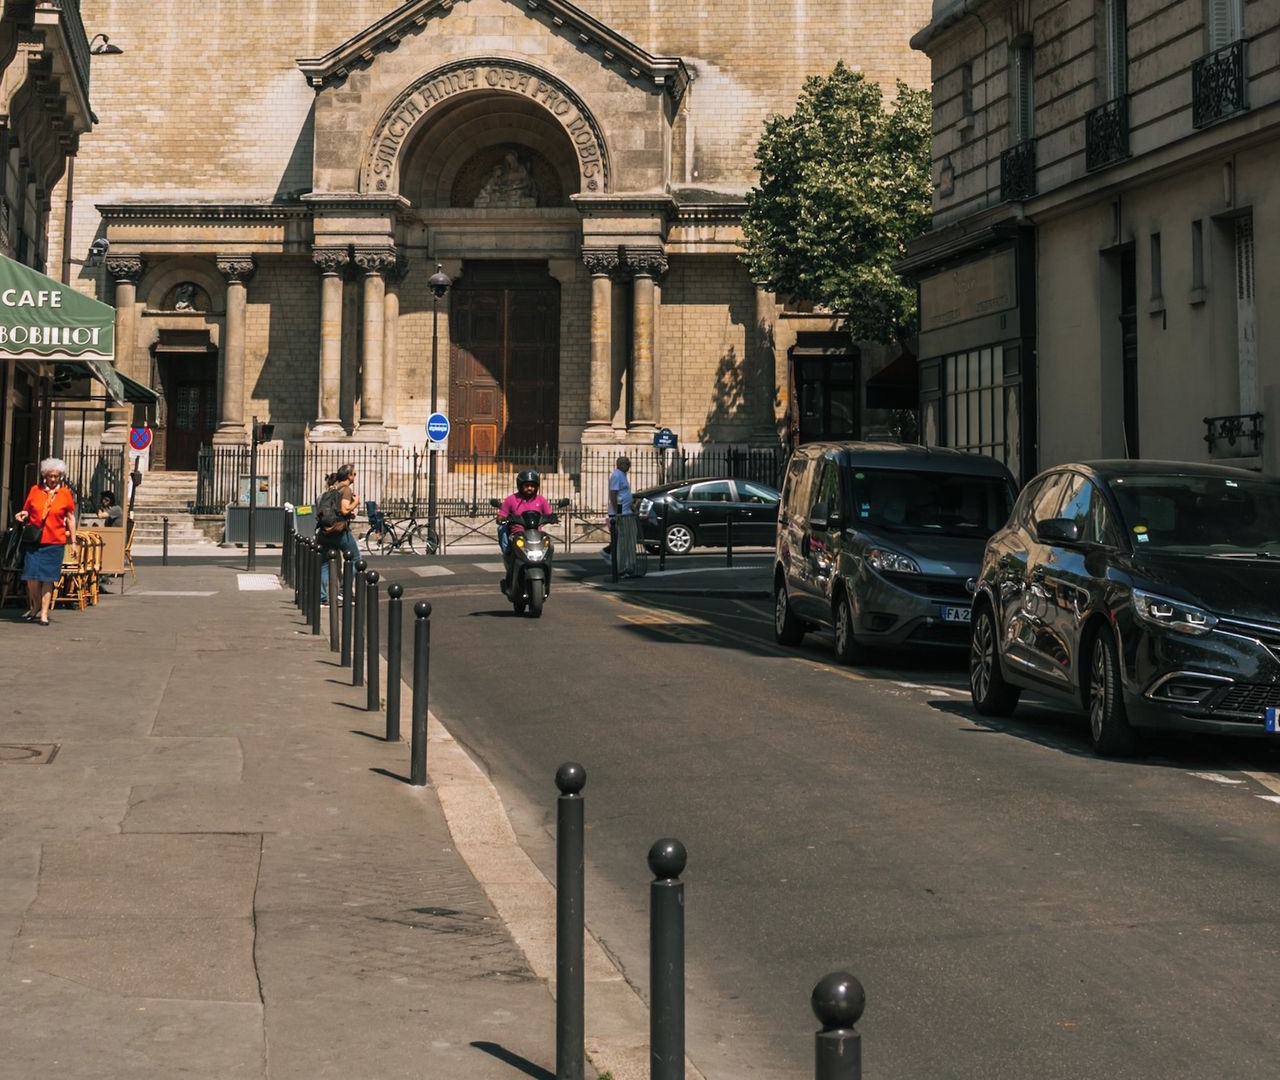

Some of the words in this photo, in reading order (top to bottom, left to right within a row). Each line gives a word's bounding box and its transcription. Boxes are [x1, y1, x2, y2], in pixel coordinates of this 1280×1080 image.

[373, 101, 423, 178] SANCTA
[418, 69, 478, 108] ANNA
[485, 69, 532, 93] ORA
[531, 82, 570, 116] PRO
[566, 117, 601, 179] NOBIS
[1, 288, 63, 309] CAFE
[946, 608, 971, 621] FA-2
